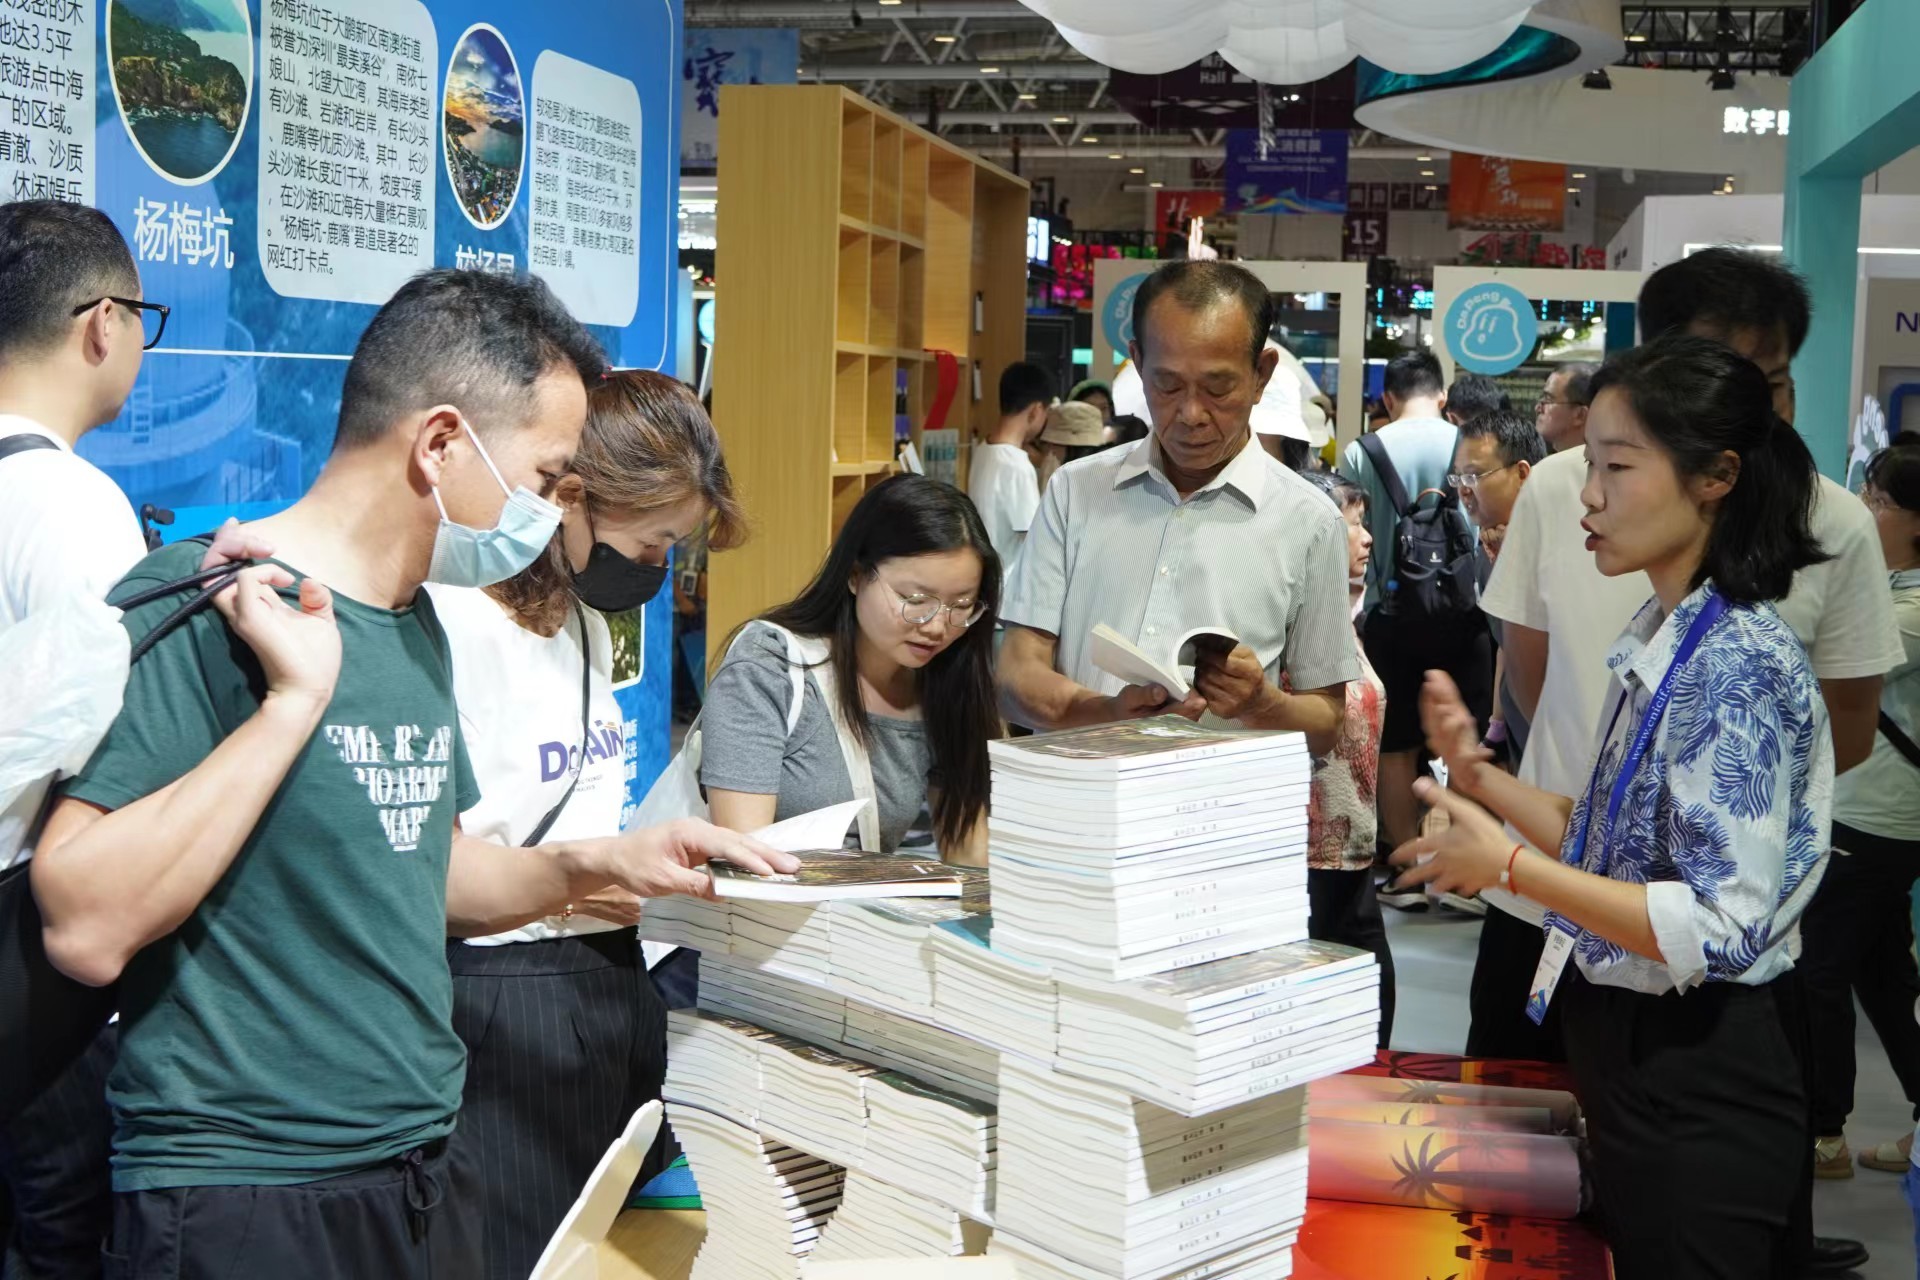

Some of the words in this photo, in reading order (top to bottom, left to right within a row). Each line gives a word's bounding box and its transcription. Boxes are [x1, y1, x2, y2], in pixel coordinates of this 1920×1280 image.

[1200, 71, 1226, 84] Hall
[133, 196, 235, 269] 杨梅坑
[1351, 219, 1380, 245] 15
[1631, 662, 1684, 761] www.cnicif.com
